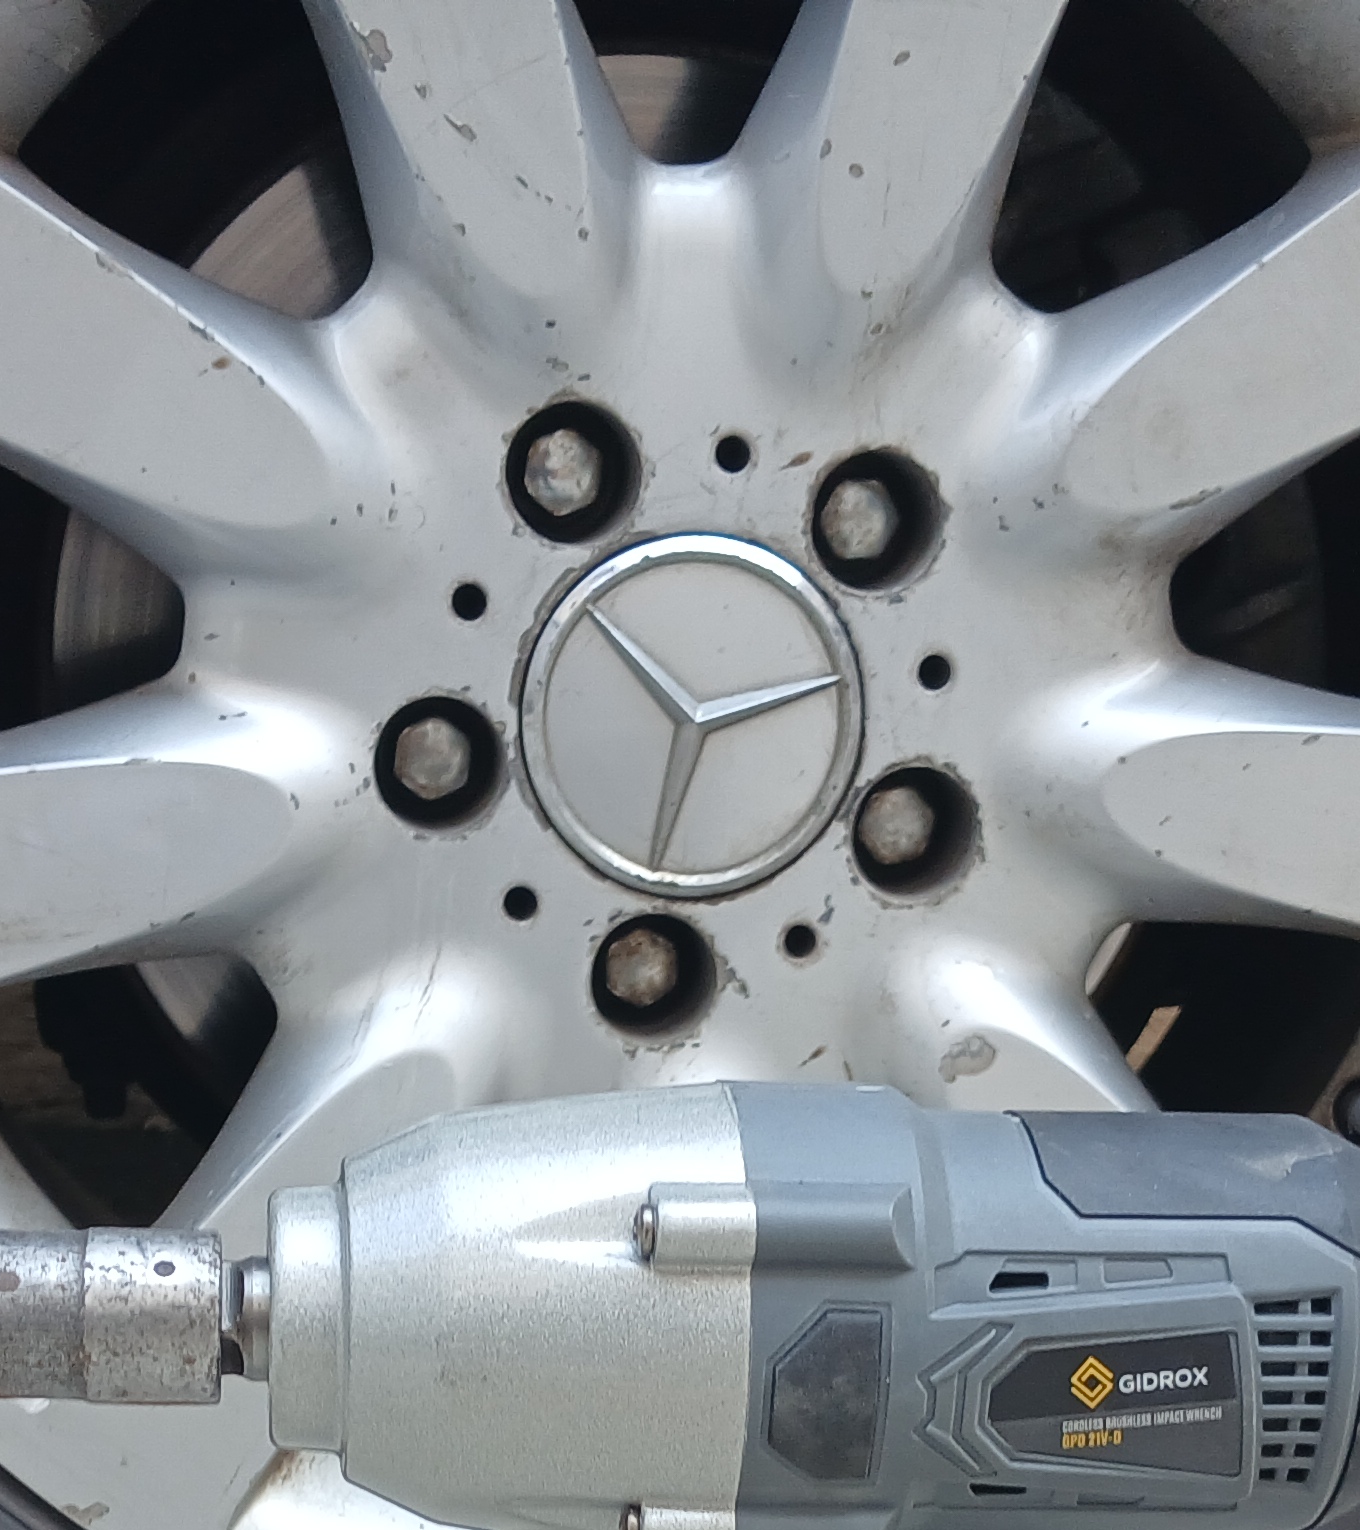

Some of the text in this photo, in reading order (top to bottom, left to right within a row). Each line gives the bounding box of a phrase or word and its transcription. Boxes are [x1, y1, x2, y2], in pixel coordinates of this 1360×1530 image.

[1118, 1366, 1209, 1394] GIDROX
[1062, 1405, 1222, 1433] CORDLESS BRUSHLESS IMPACT WRENCH
